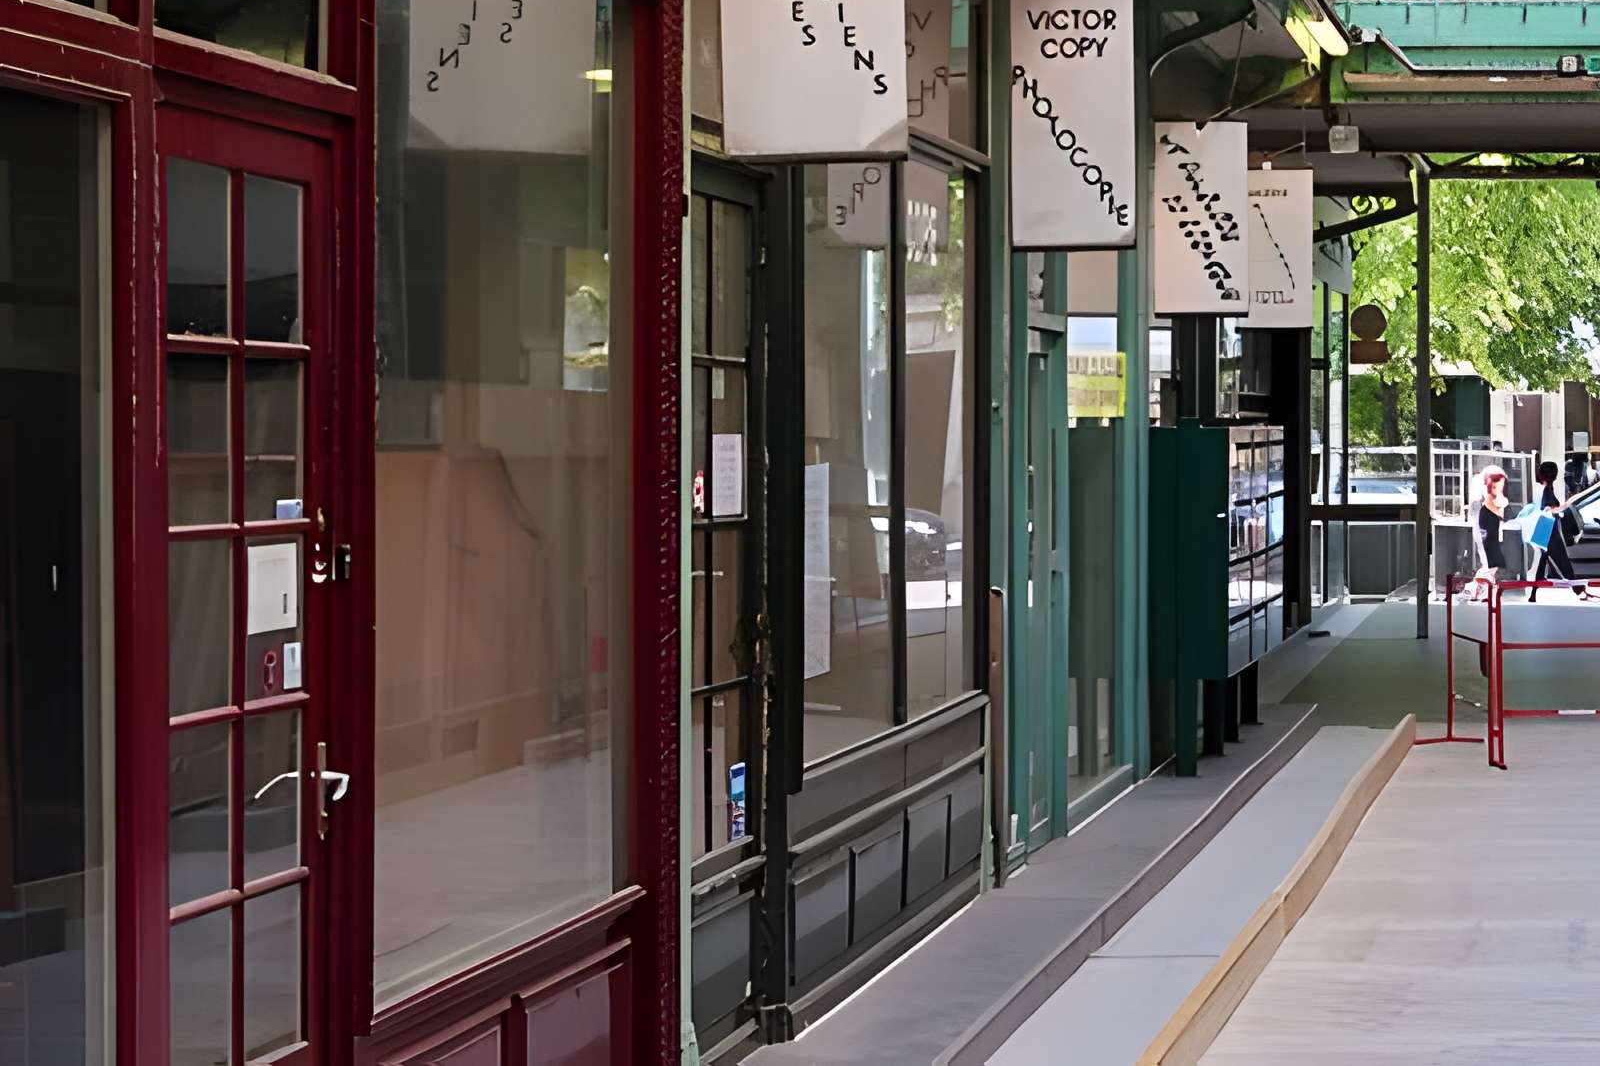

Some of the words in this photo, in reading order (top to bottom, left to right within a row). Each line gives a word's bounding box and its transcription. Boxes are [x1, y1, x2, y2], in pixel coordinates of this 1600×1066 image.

[1026, 9, 1117, 30] VICTOR
[1040, 36, 1108, 58] COPY
[1011, 64, 1129, 226] PHOTOCOPIE
